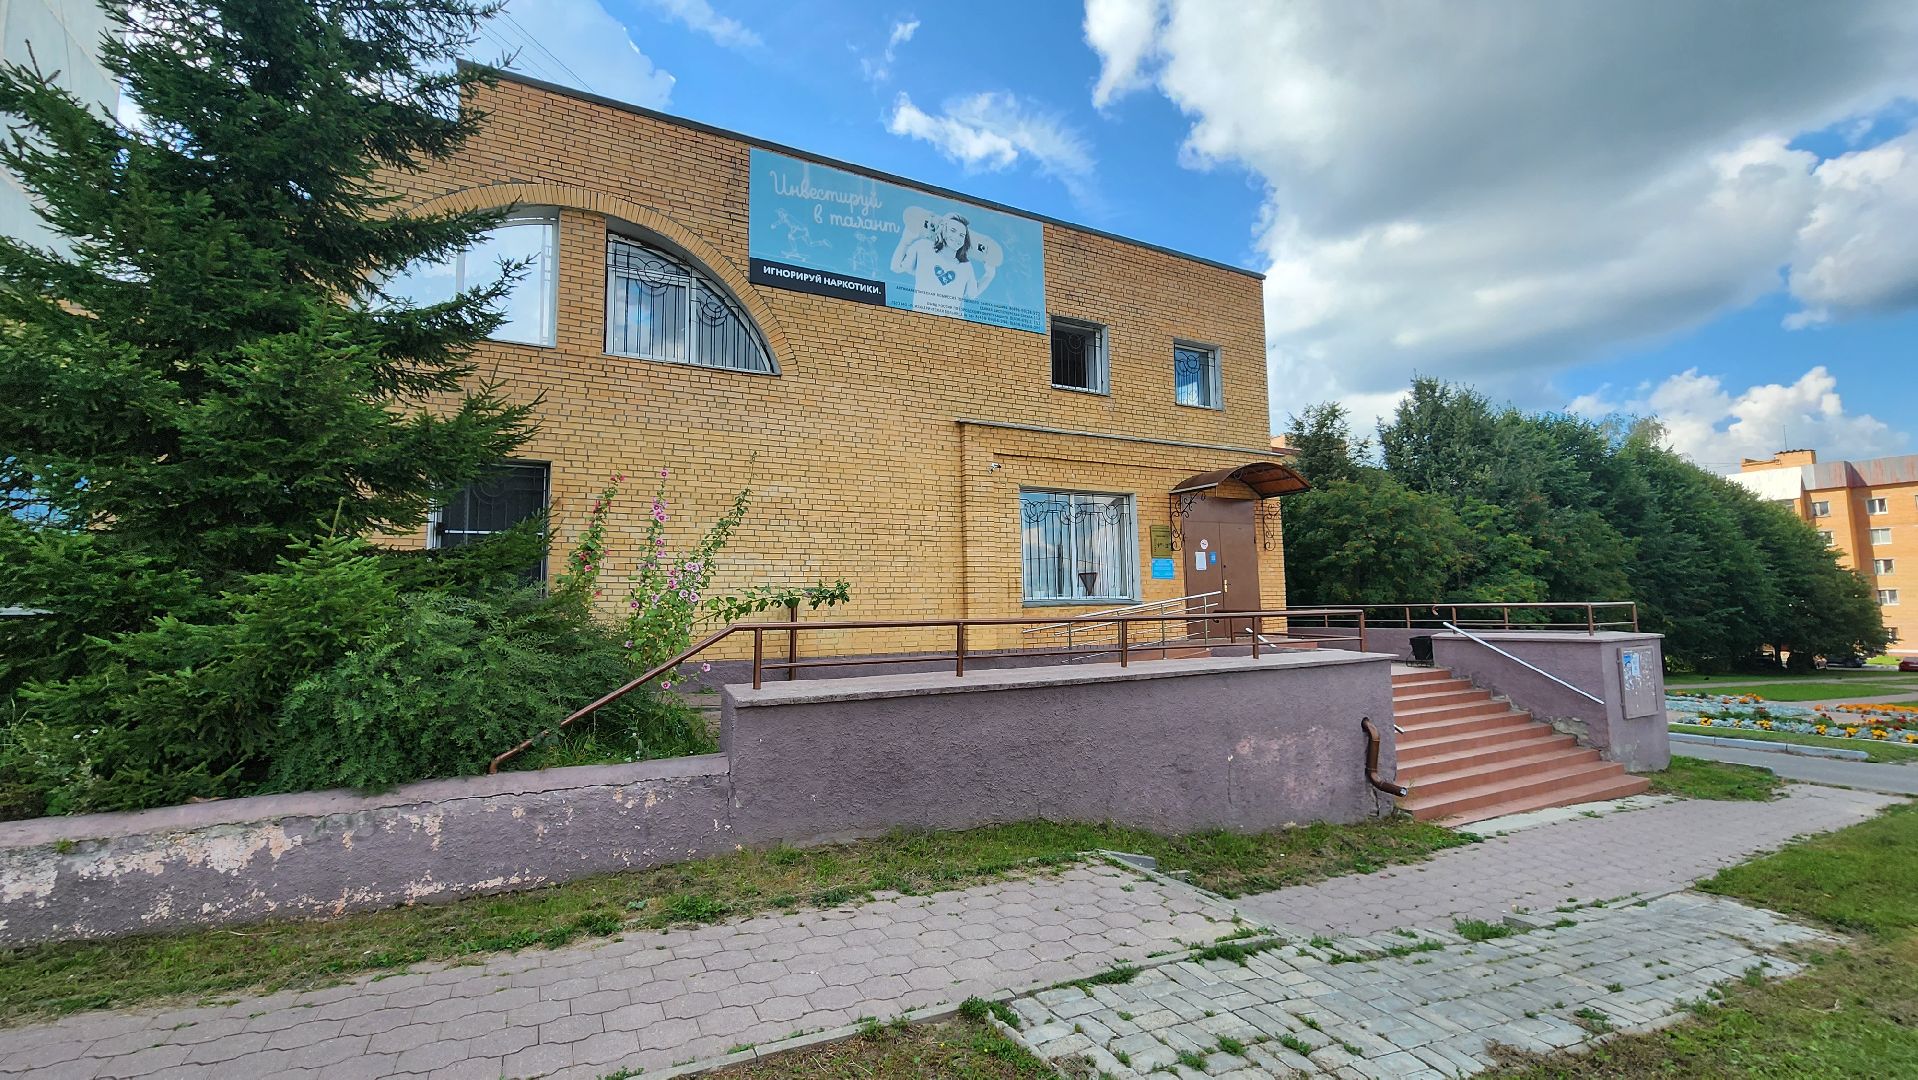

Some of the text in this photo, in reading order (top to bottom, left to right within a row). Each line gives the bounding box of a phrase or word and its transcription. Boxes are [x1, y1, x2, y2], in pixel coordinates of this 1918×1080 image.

[769, 170, 883, 216] Инвестируй
[814, 203, 900, 234] в талант
[763, 265, 882, 295] ИГНОРИРУЙ НАРКОТИКИ.
